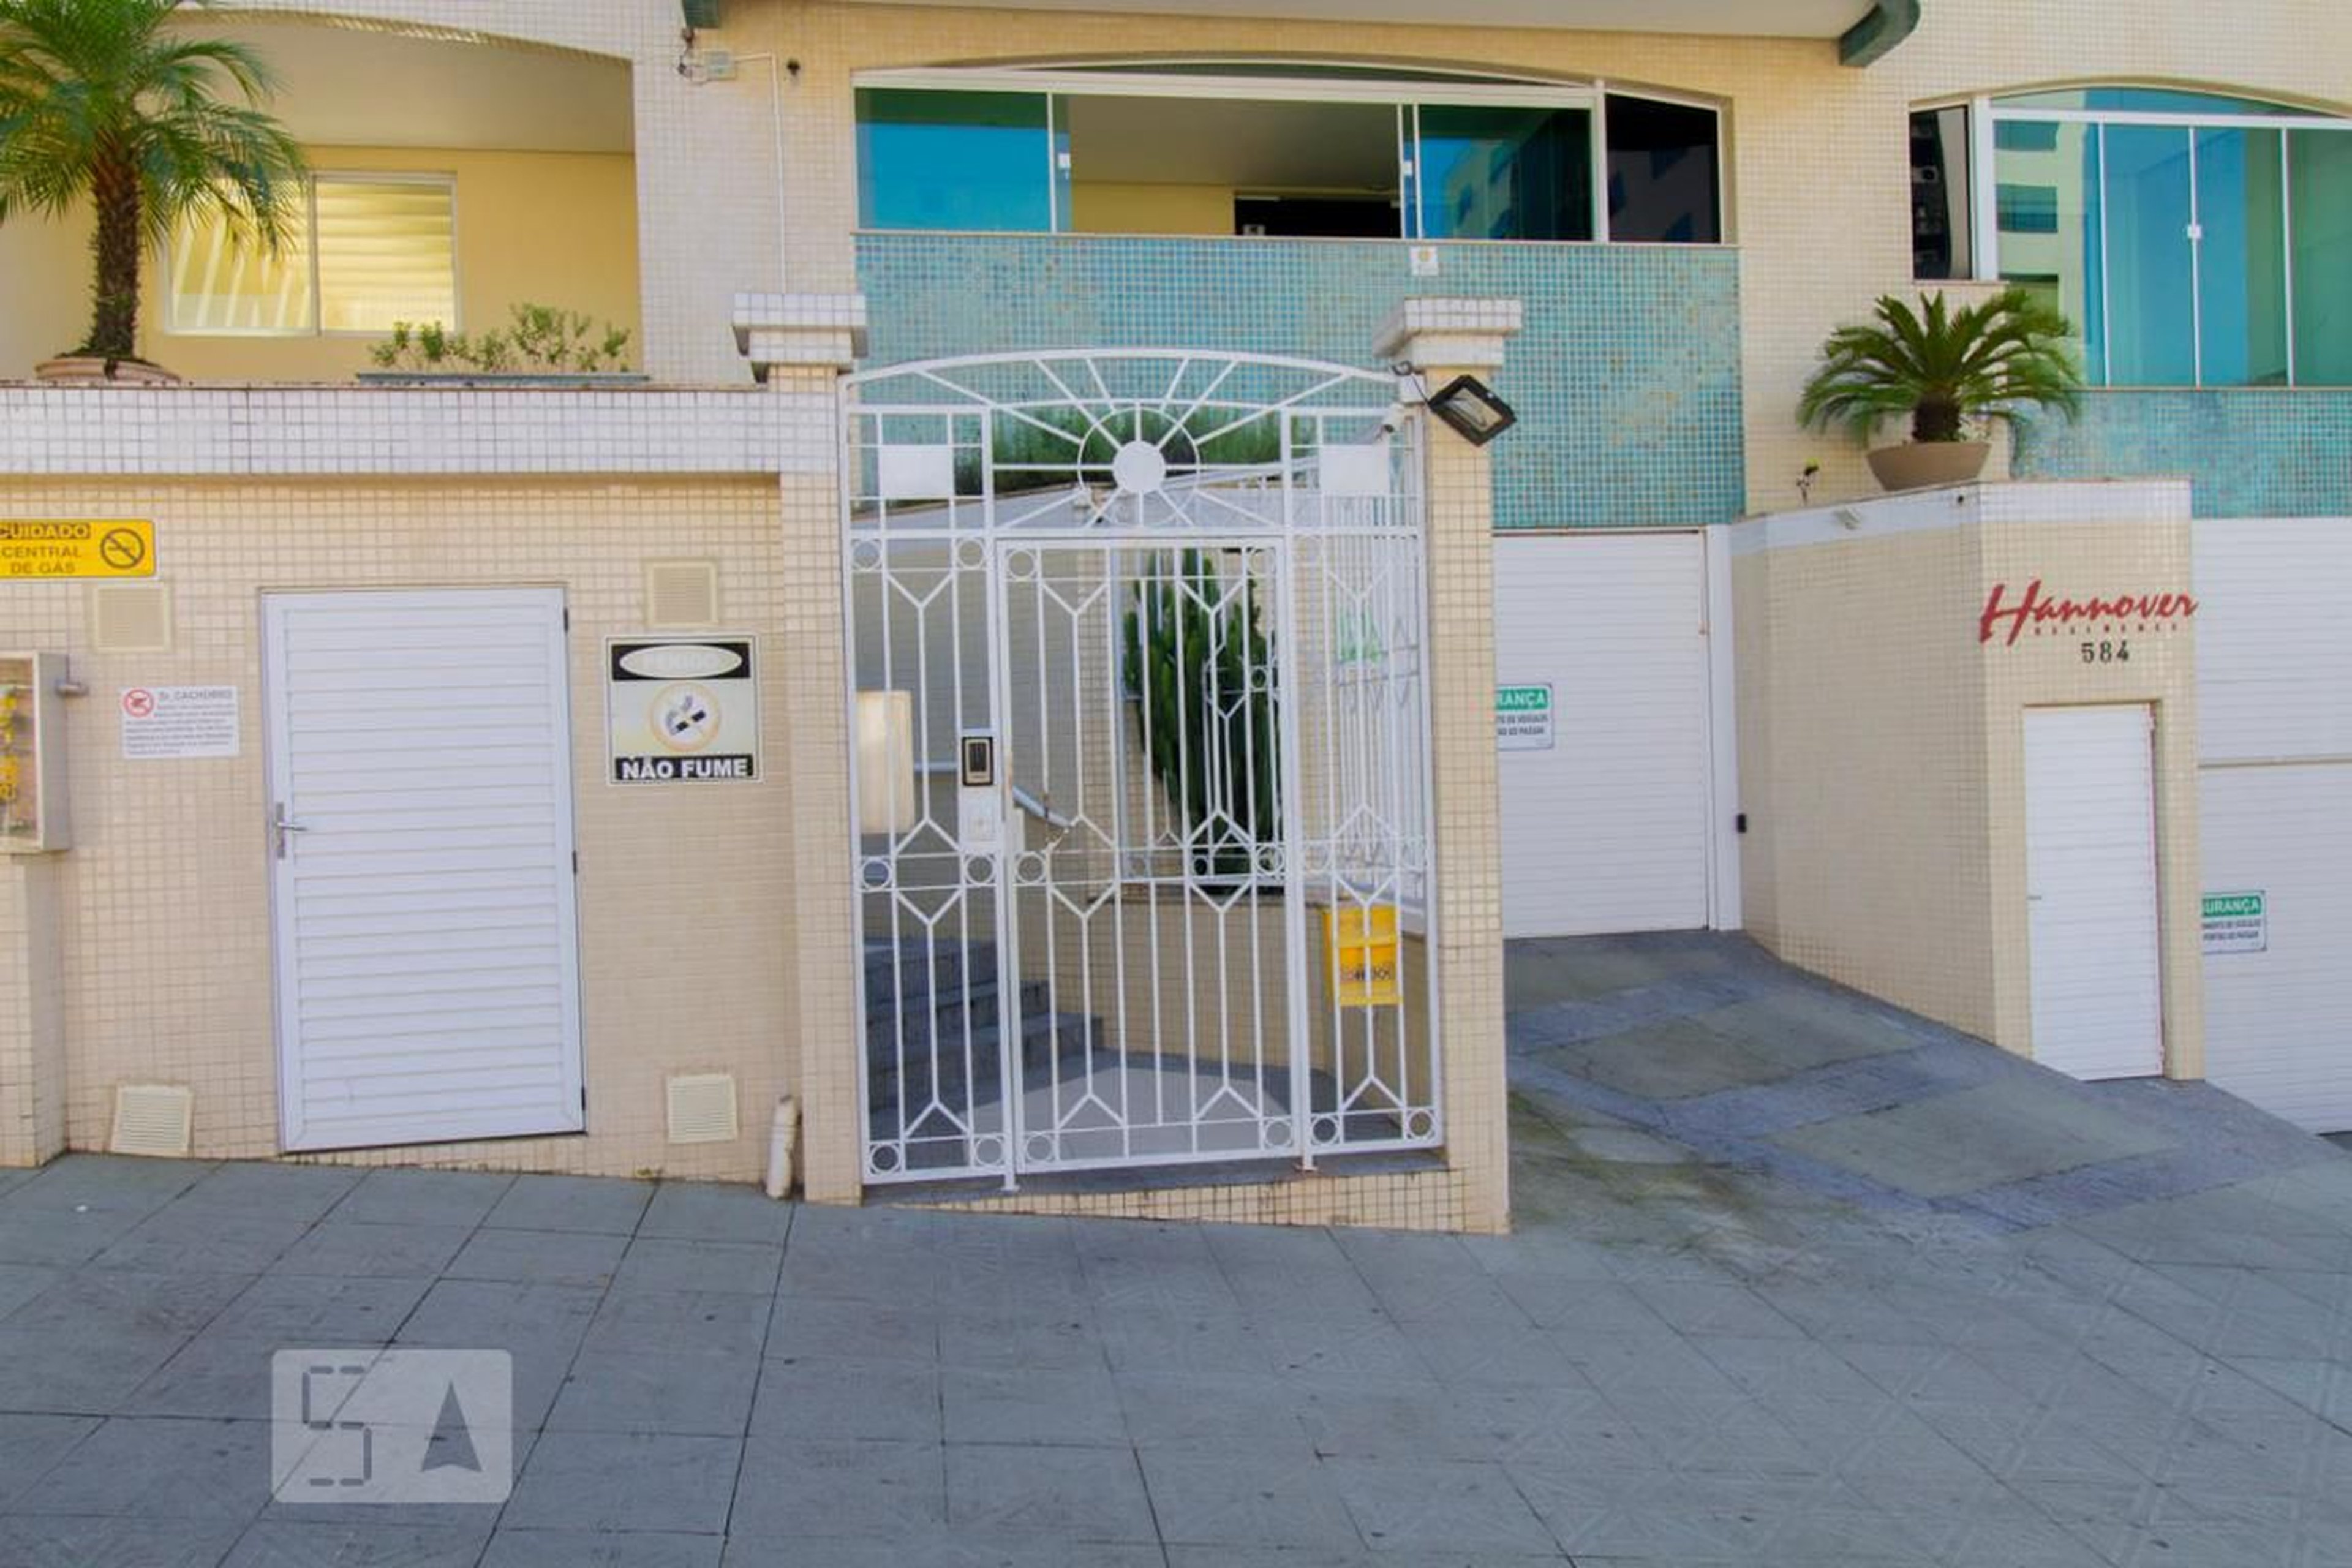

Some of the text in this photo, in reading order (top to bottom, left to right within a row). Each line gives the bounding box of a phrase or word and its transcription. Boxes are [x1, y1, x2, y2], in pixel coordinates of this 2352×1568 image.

[0, 524, 88, 539] CUIDADO
[2, 546, 82, 558] CENTRAL
[11, 562, 33, 574] DE
[1979, 579, 2199, 646] Hannover
[2082, 641, 2129, 663] 584
[622, 757, 747, 778] NÃO FUME
